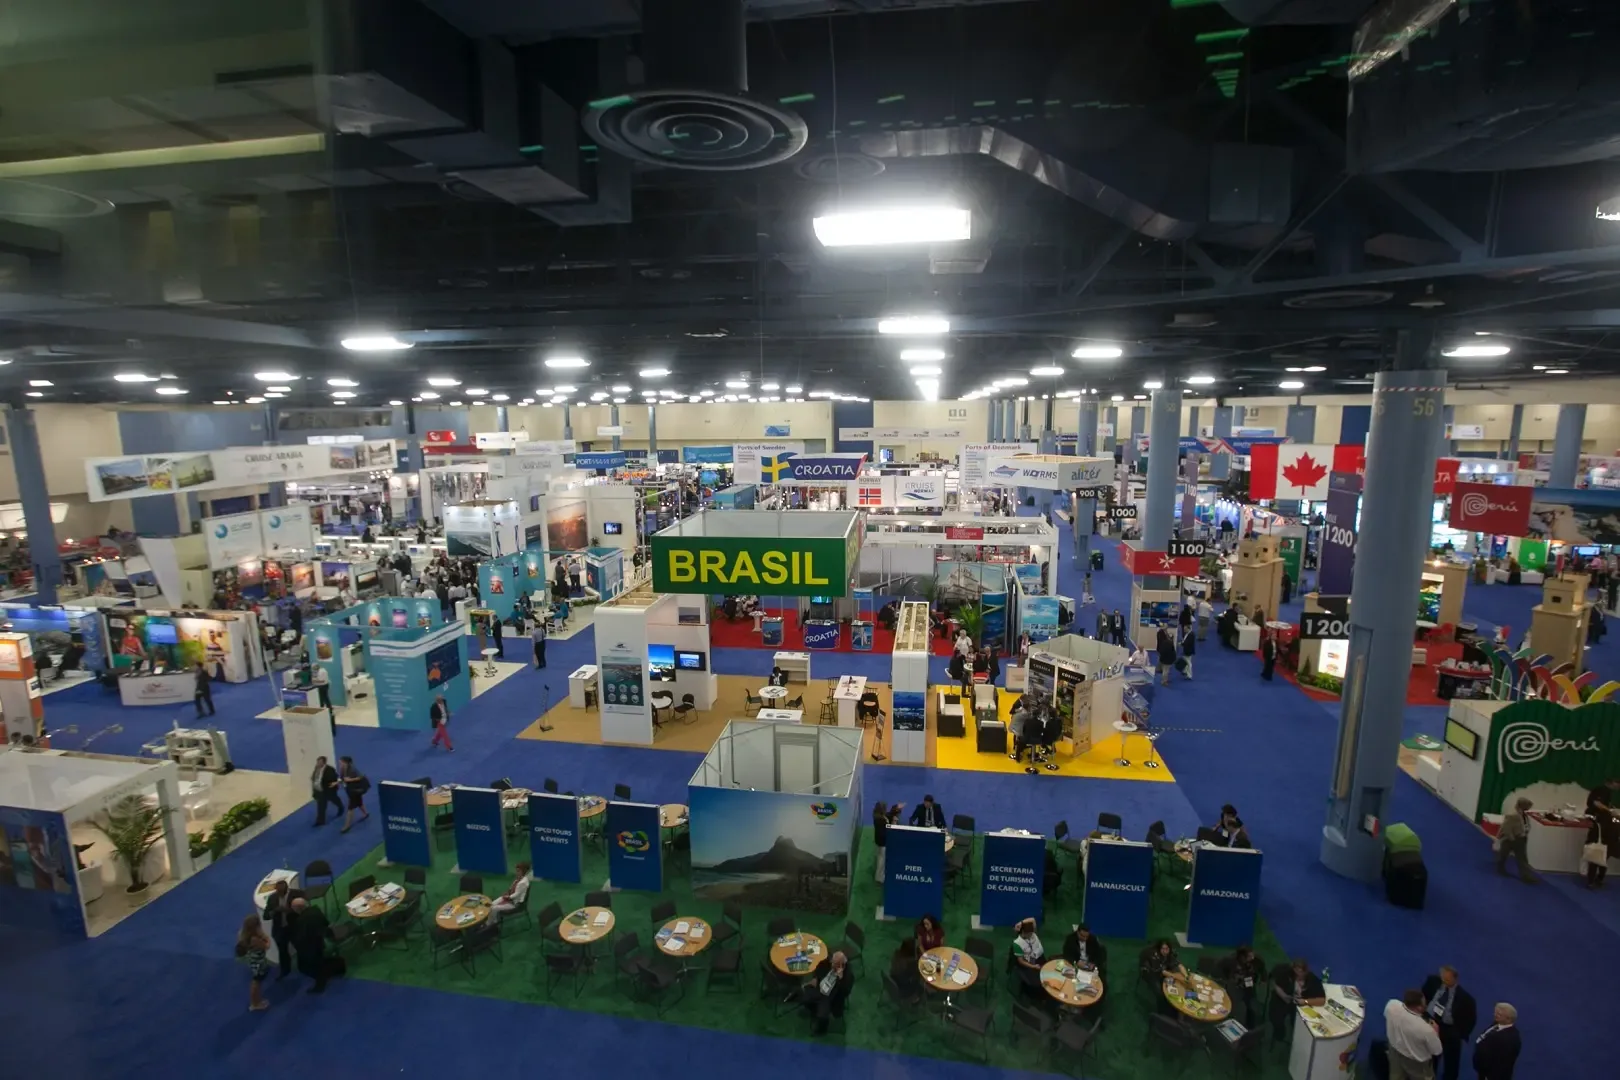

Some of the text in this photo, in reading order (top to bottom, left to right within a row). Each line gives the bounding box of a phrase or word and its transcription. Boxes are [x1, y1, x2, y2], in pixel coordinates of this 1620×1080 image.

[1412, 398, 1435, 416] 56
[794, 464, 855, 476] CROATIA
[1111, 508, 1136, 517] 1000
[1460, 492, 1519, 521] Perú
[1325, 524, 1353, 548] 1200
[1171, 544, 1204, 556] 1100
[668, 549, 829, 586] BRASIL
[805, 629, 839, 644] CROATIA
[1498, 722, 1600, 773] Perú
[546, 836, 569, 844] EVENTS
[904, 864, 922, 873] PIER
[990, 865, 1034, 875] SECRETARIA
[1001, 876, 1034, 884] TURISMO
[998, 884, 1019, 892] CABO
[1020, 886, 1038, 894] FRIO
[1090, 881, 1146, 892] MANAUSCULT
[1200, 888, 1250, 900] AMAZONAS
